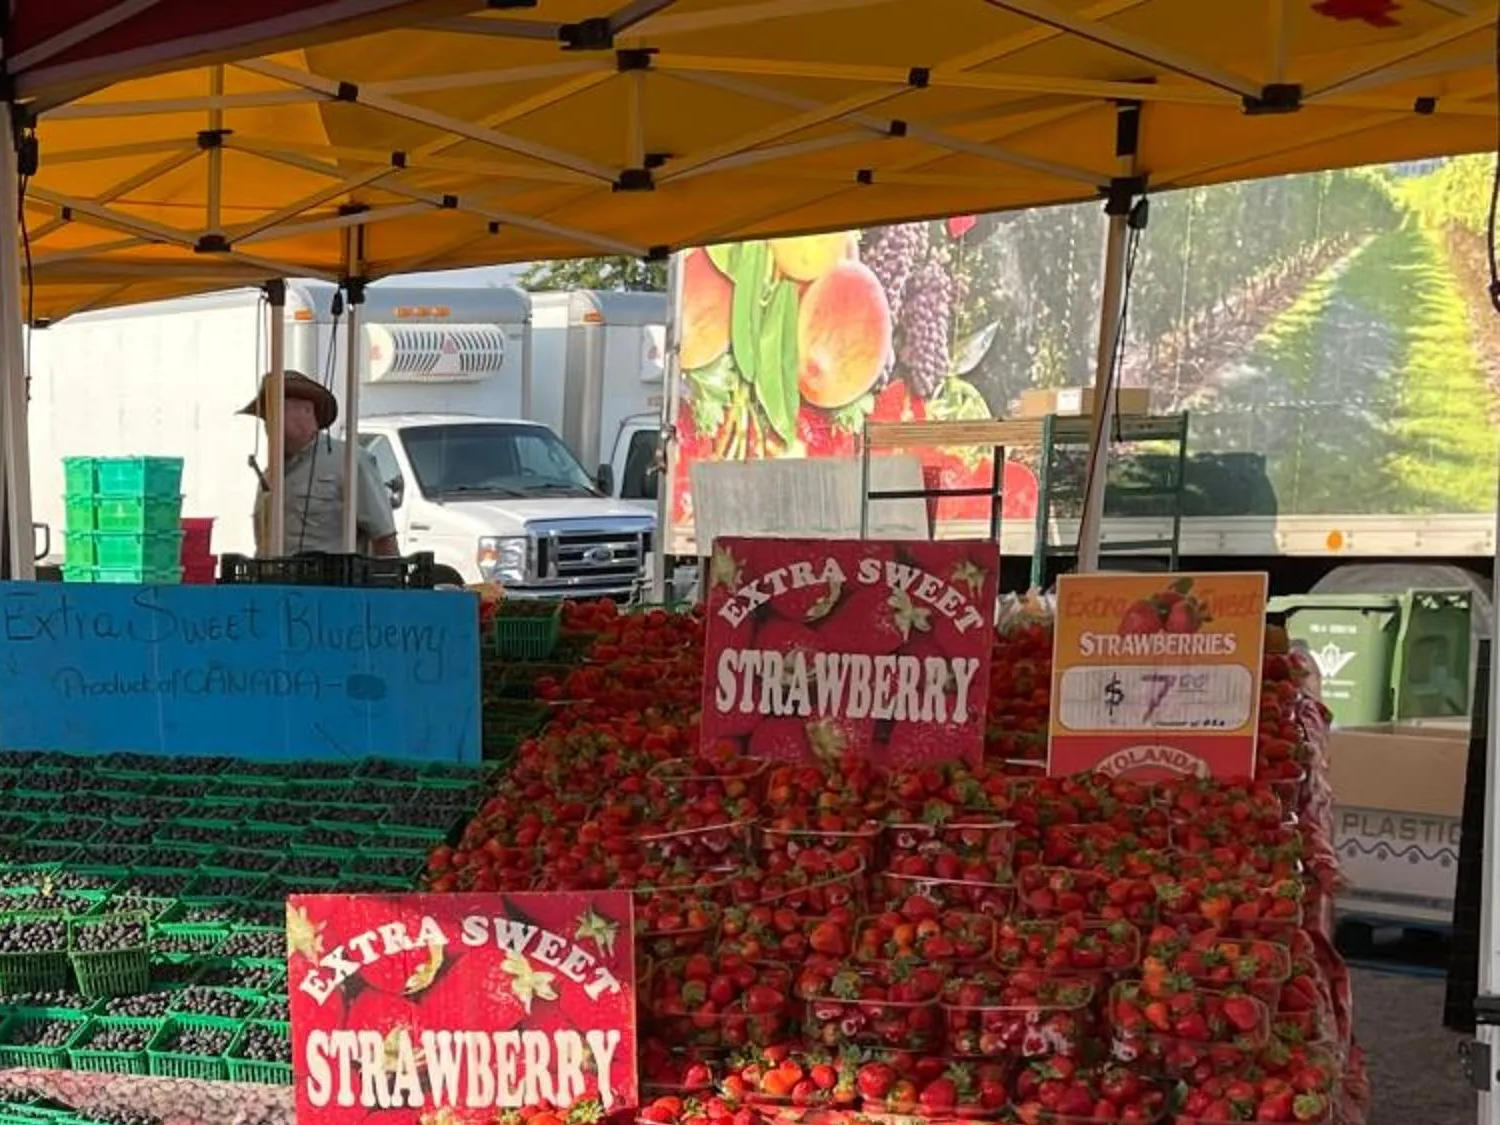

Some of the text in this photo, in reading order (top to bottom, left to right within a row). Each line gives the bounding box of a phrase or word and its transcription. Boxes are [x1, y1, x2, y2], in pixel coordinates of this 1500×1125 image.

[718, 557, 984, 634] EXTRA SWEET
[5, 591, 122, 641] Extra
[282, 591, 447, 685] Blueberry
[716, 648, 980, 723] STRAWBERRY
[300, 915, 621, 1006] EXTRA SWEET
[306, 1029, 621, 1110] STRAWBERRY
